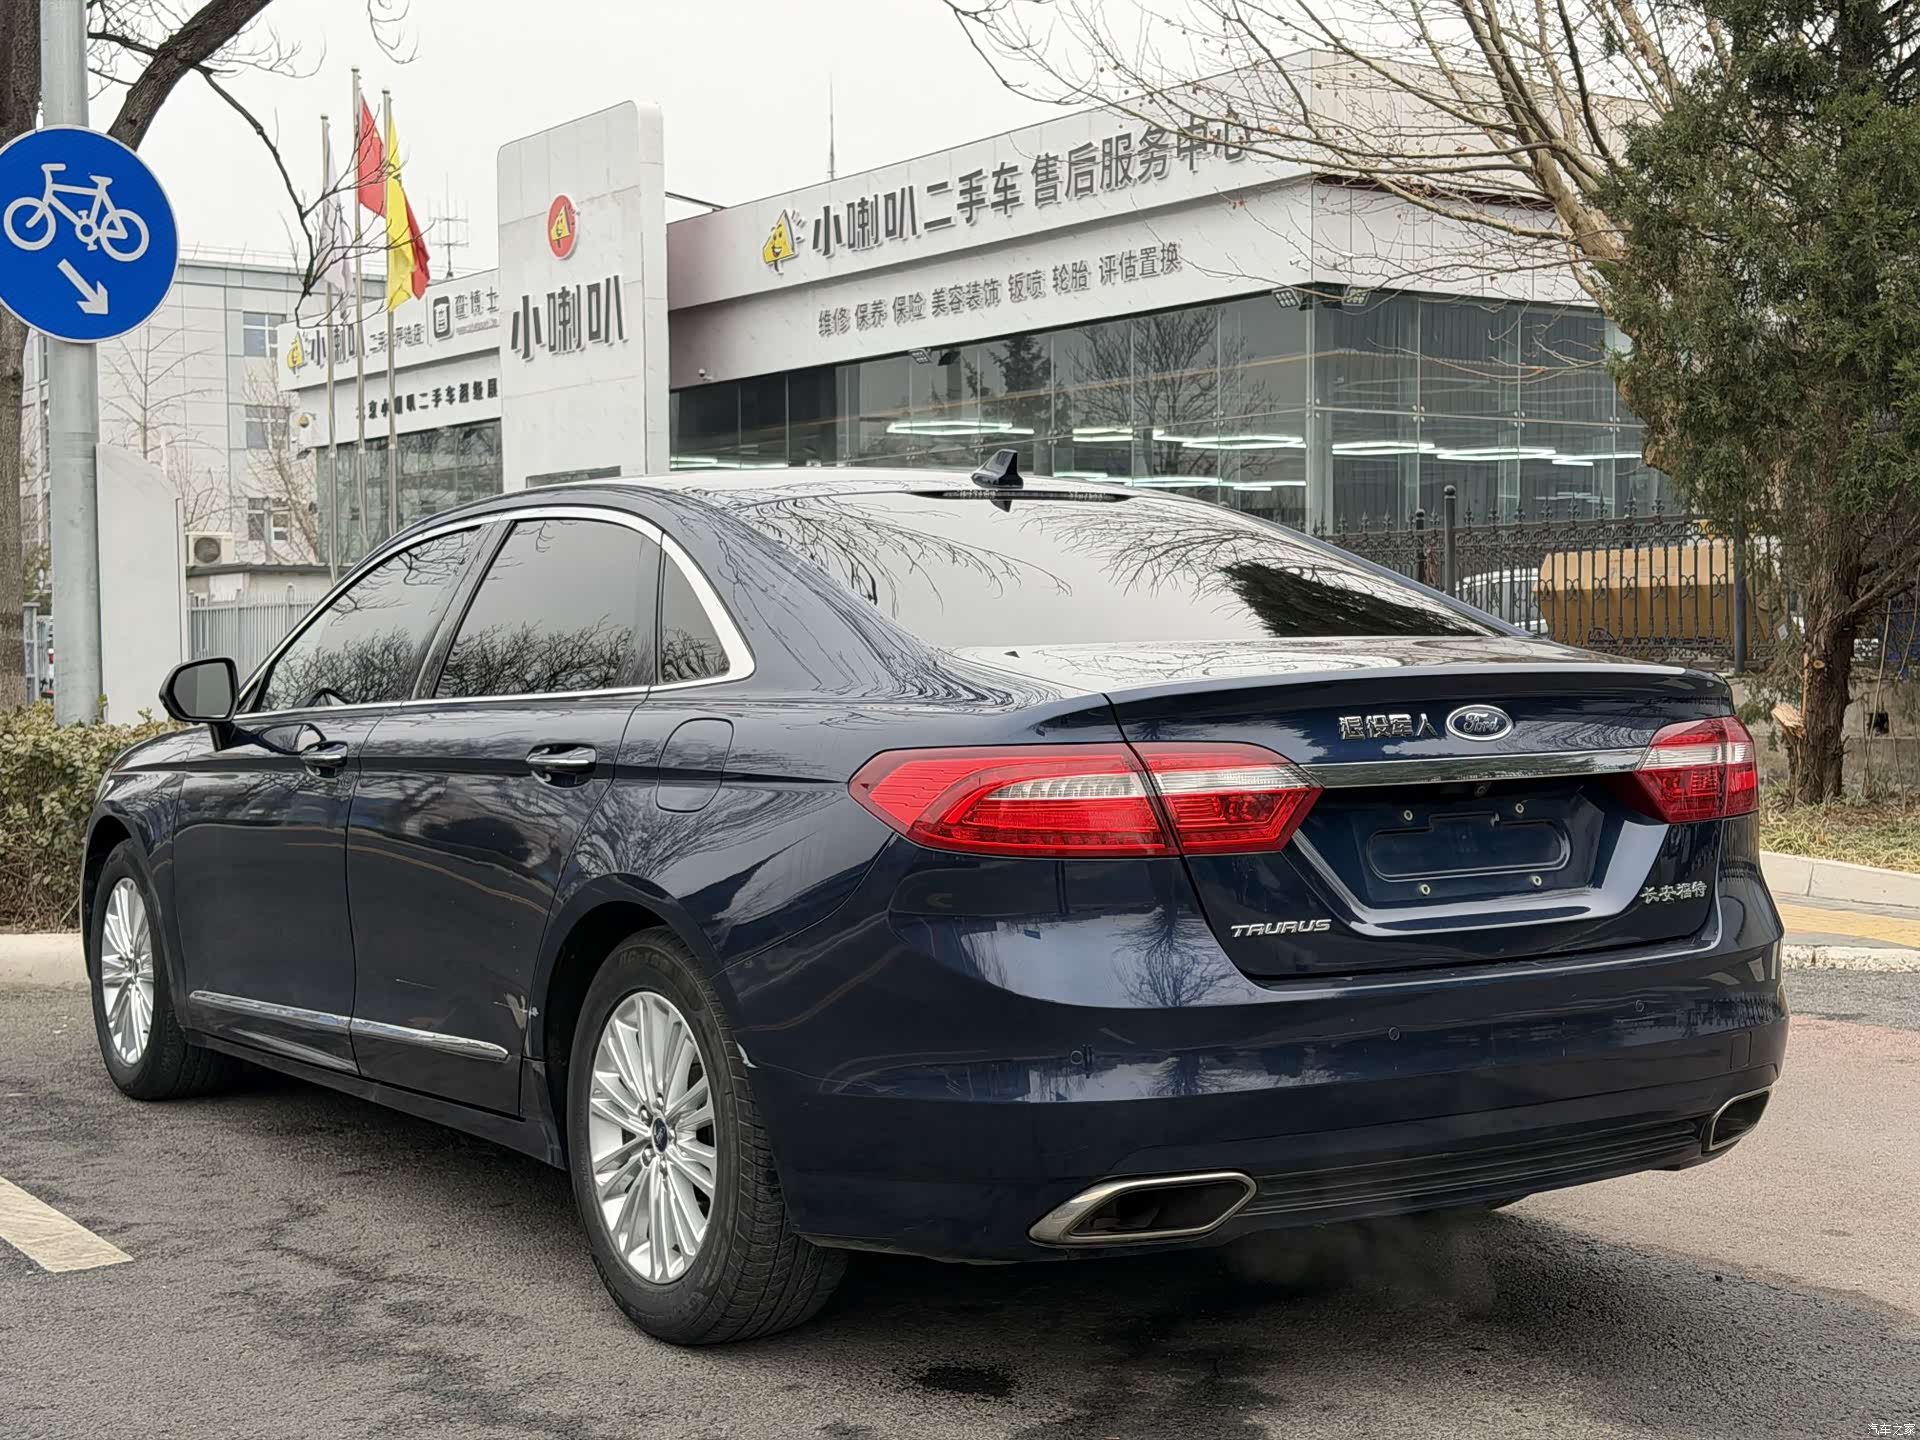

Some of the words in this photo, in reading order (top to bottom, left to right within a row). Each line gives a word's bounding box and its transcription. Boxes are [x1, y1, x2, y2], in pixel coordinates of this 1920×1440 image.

[818, 307, 850, 337] 维修
[855, 299, 887, 331] 保养
[892, 292, 926, 325] 保险
[931, 278, 1001, 317] 美容装饰
[1008, 270, 1045, 302] 钣喷
[1052, 260, 1090, 294] 轮胎
[1098, 242, 1181, 286] 评估置换
[511, 275, 624, 360] 小喇叭
[1463, 712, 1501, 733] Ford
[1640, 881, 1707, 904] 长安福特
[1230, 919, 1332, 937] TAURUS
